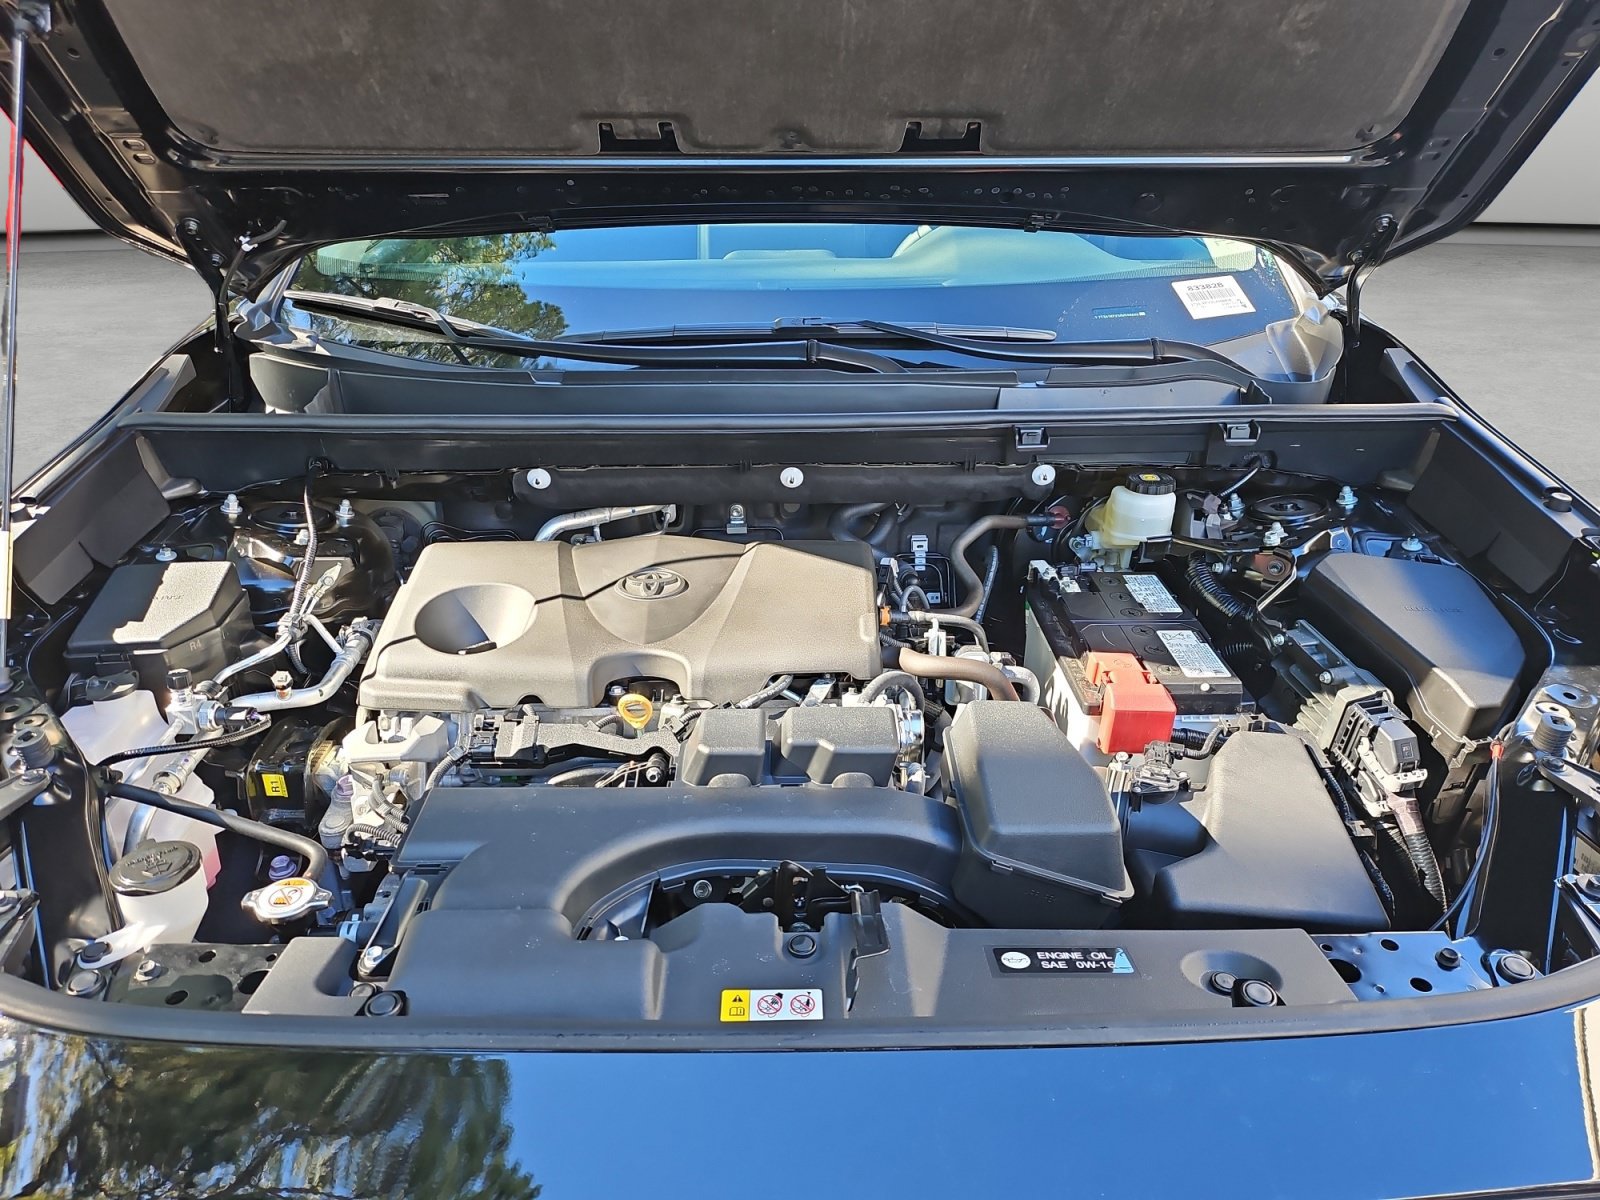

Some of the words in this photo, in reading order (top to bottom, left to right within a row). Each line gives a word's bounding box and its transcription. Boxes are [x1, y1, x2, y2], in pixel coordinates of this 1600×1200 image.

[1036, 951, 1084, 960] ENGINE
[1090, 951, 1113, 960] OIL
[1041, 960, 1069, 969] SAE
